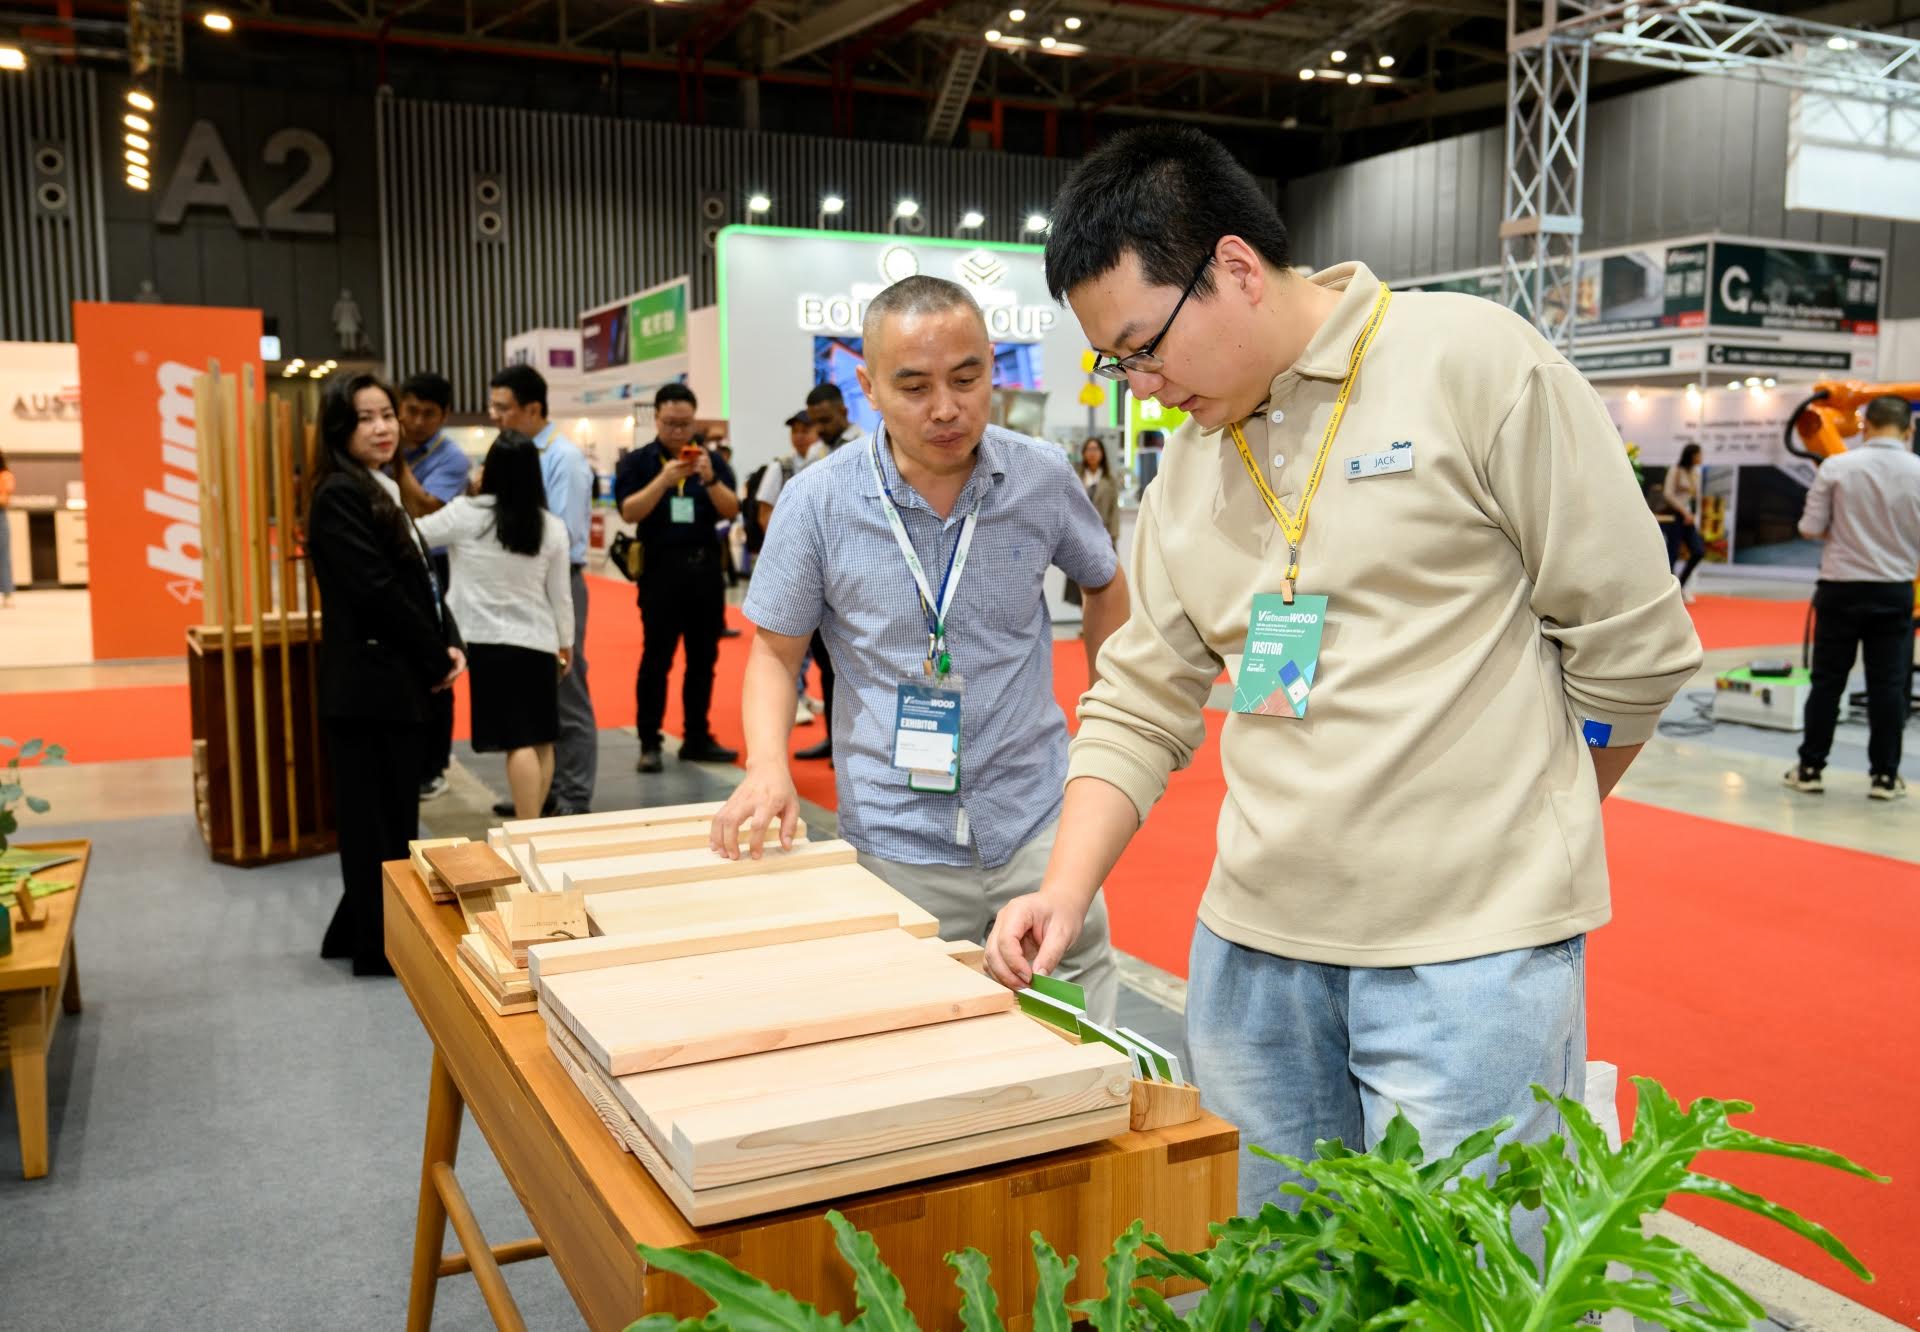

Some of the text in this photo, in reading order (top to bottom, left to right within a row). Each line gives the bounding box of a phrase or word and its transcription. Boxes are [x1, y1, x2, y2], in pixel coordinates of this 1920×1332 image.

[155, 120, 336, 233] A2
[1374, 456, 1395, 468] JACK
[144, 361, 205, 580] blum
[1251, 641, 1283, 655] VISITOR
[900, 717, 937, 730] EXHIBITOR
